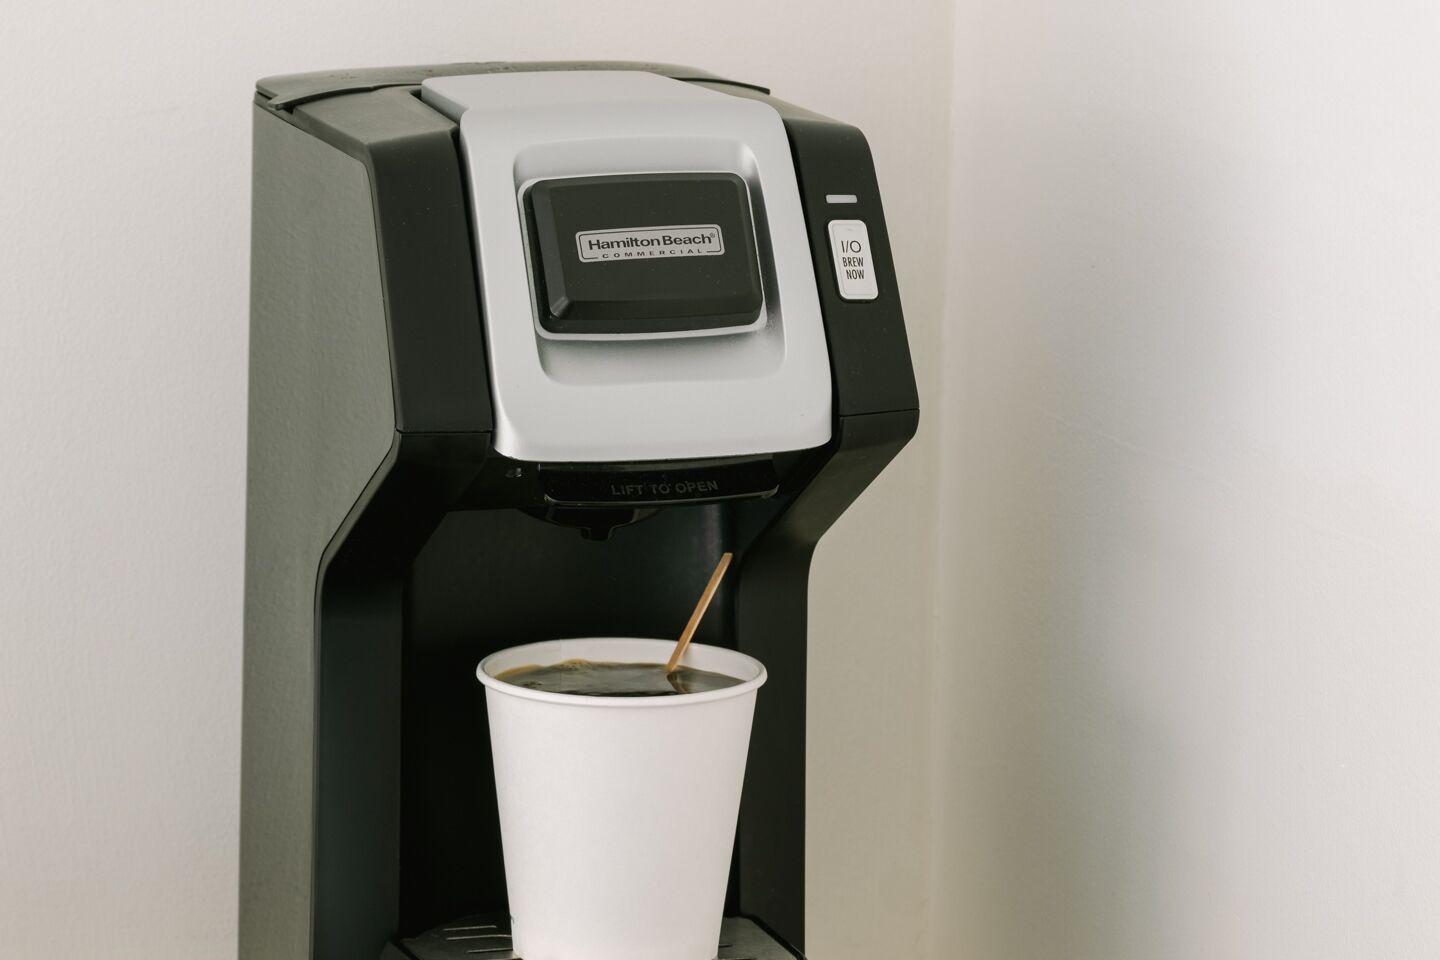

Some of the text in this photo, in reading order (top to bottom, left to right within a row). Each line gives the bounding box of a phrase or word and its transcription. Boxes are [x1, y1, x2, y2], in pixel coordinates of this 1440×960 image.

[588, 237, 664, 251] Hamilton
[602, 249, 703, 259] COMMERCIAL
[842, 257, 864, 267] BREW
[846, 269, 865, 280] NOW
[611, 480, 719, 495] LIFT TO OPEN
